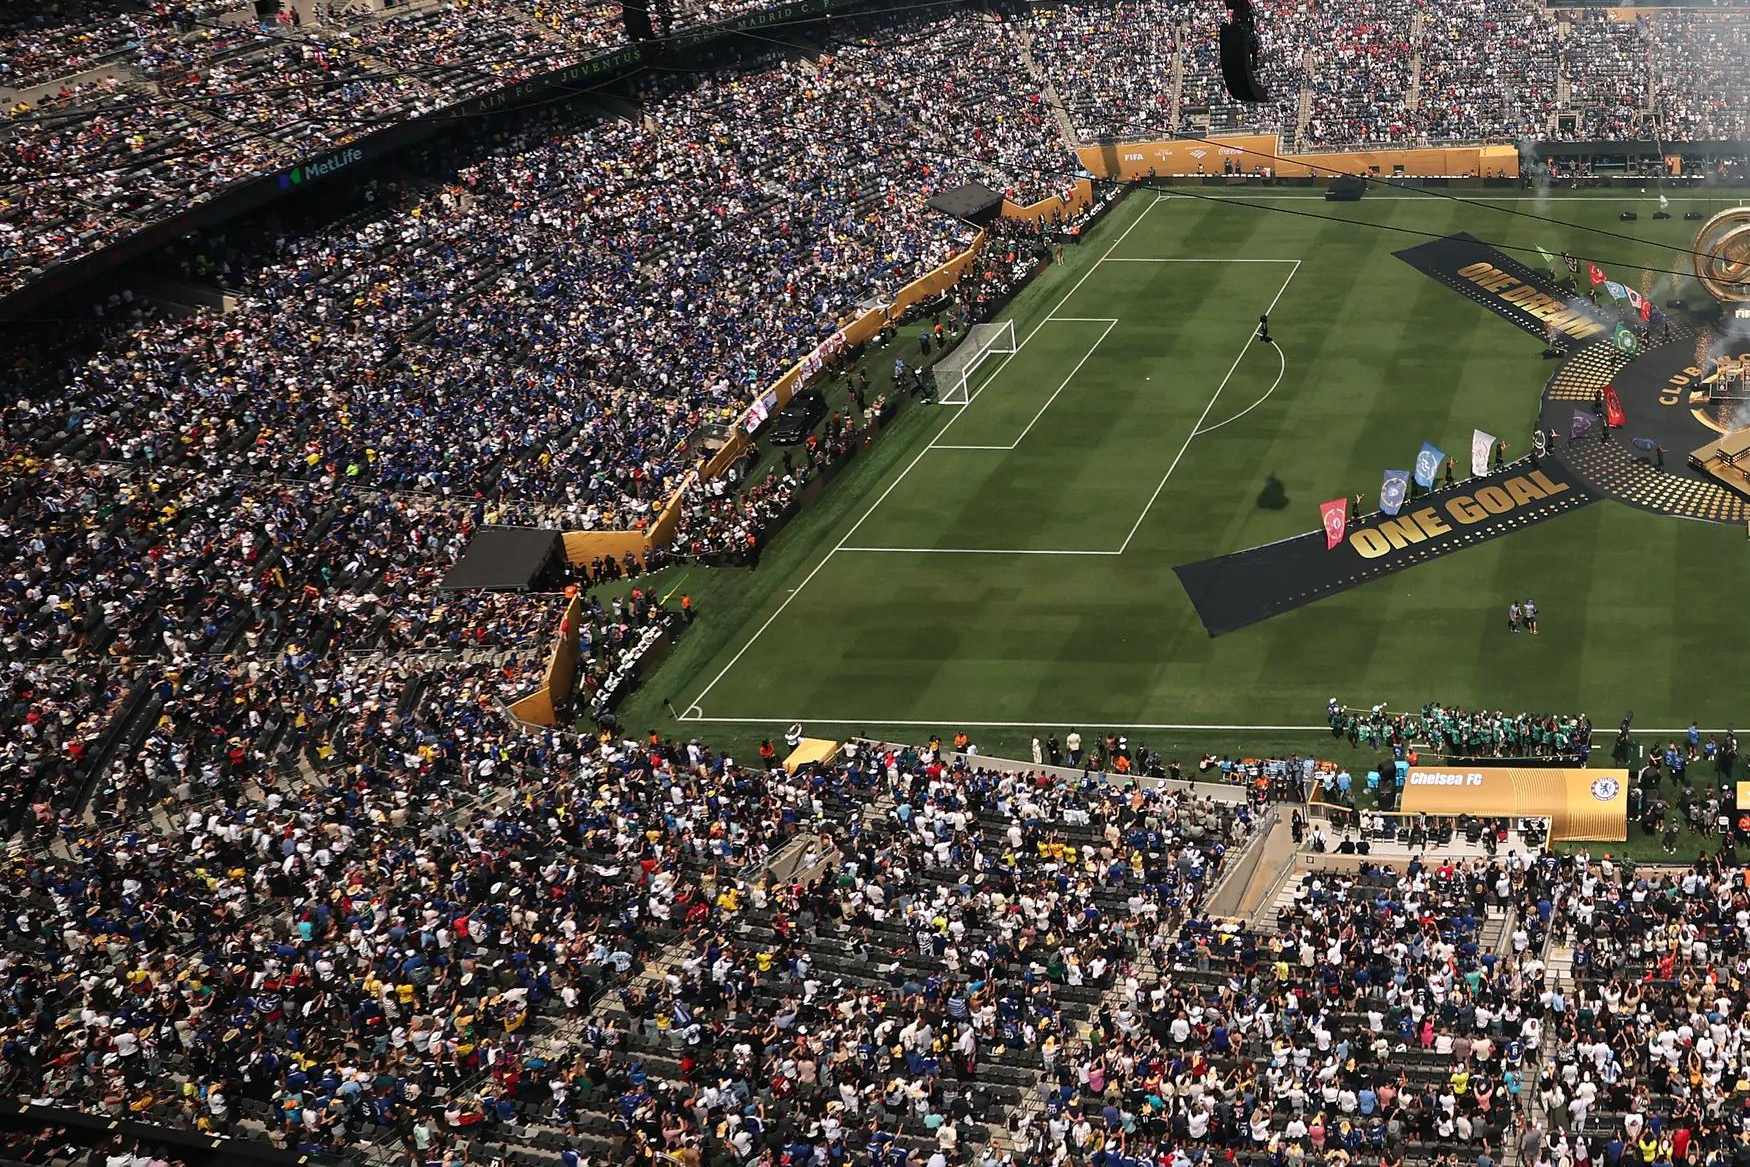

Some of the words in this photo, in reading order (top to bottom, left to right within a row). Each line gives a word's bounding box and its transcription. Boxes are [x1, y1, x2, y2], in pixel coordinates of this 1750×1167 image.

[738, 8, 792, 29] MADRID
[561, 49, 641, 82] JUVENTUS
[479, 93, 506, 110] AIN
[516, 83, 534, 97] FC
[304, 148, 363, 180] MetLife
[1124, 153, 1144, 162] FIFA
[1457, 261, 1522, 293] ONE
[1497, 284, 1606, 340] DREAM
[1658, 365, 1703, 406] CLUB
[1348, 506, 1452, 559] ONE
[1444, 469, 1570, 525] GOAL
[1409, 772, 1463, 786] Chelsea
[1466, 773, 1482, 786] FC
